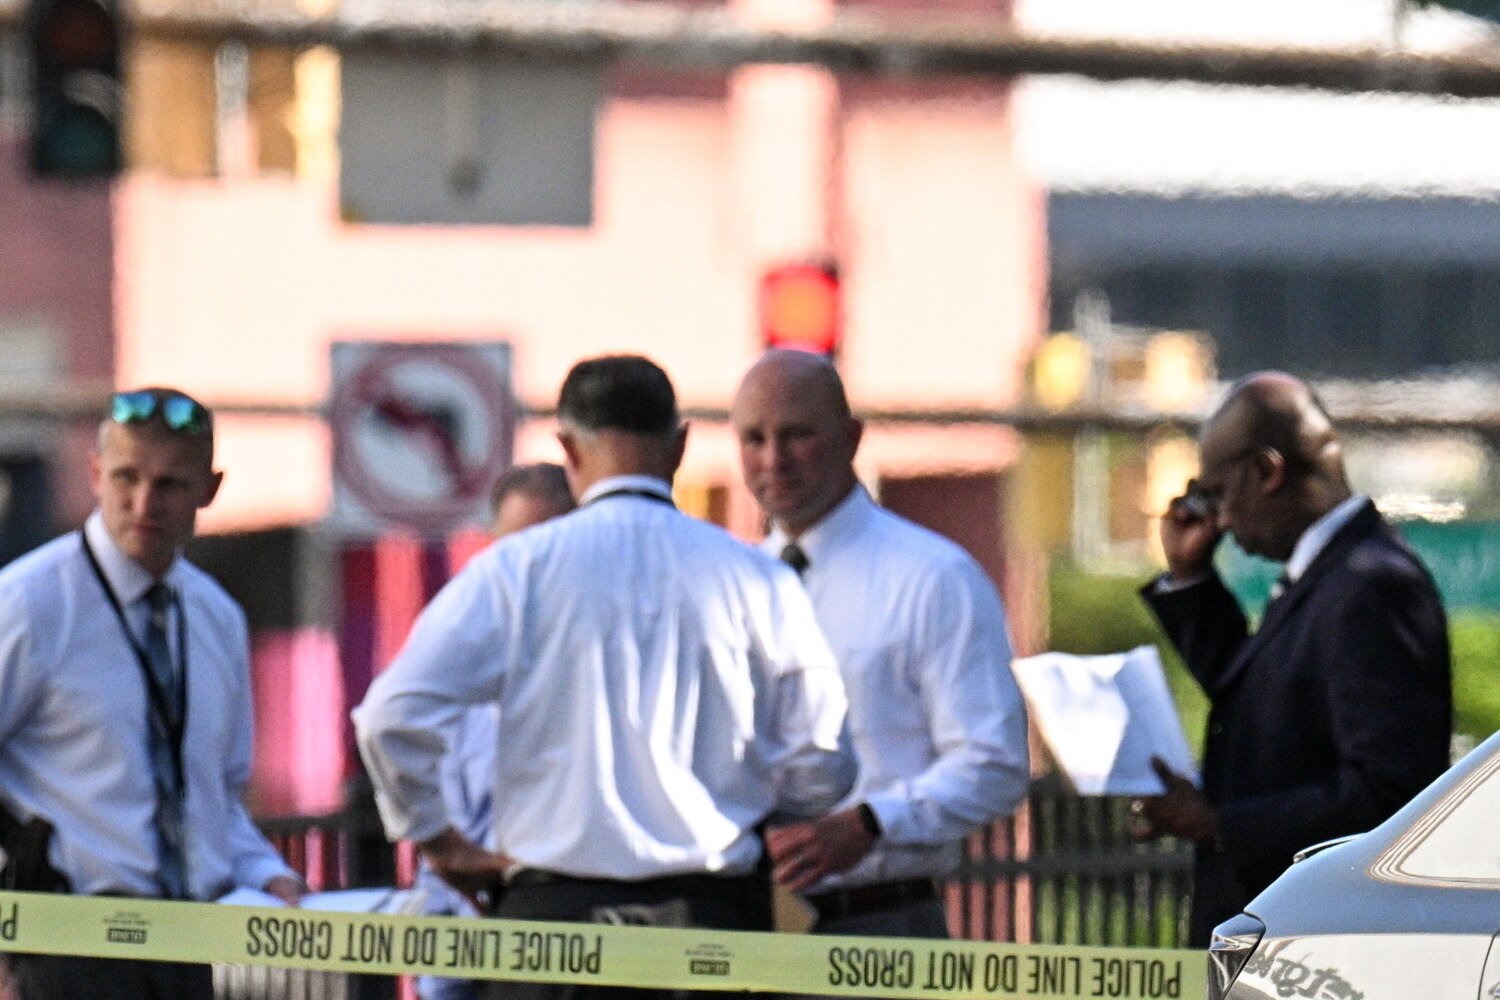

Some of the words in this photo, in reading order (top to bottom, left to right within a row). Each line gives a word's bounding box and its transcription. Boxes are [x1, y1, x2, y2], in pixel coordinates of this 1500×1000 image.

[247, 916, 332, 960] CROSS
[341, 922, 394, 963] NOT
[403, 926, 437, 966] DO
[446, 928, 501, 969] LINE
[510, 931, 603, 975] POLICE
[829, 946, 914, 987] CROSS
[923, 950, 974, 991] NOT
[984, 953, 1017, 993] DO
[1027, 955, 1081, 996] LINE
[1091, 957, 1182, 999] POLICE
